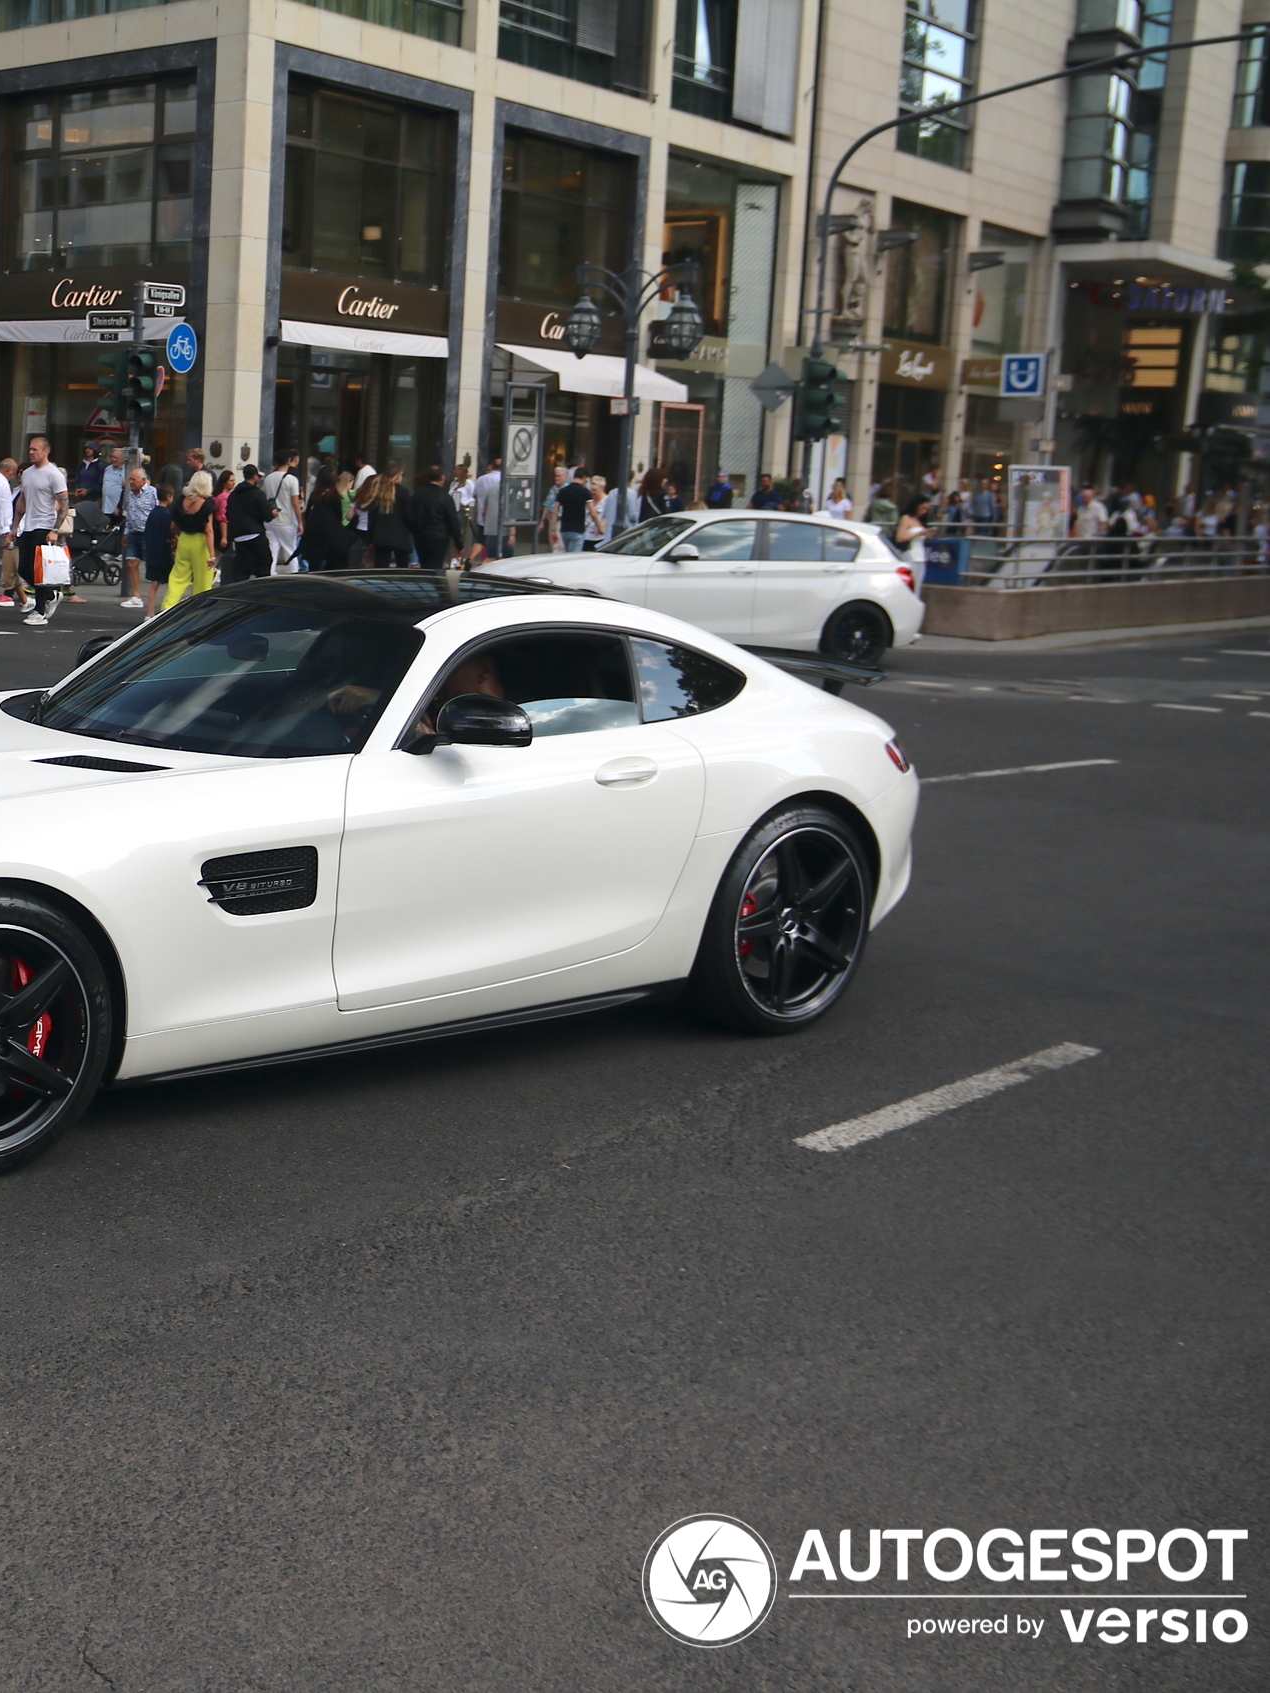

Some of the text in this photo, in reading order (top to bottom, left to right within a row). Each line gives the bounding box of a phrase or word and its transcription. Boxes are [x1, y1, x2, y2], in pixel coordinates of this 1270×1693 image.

[51, 278, 123, 308] Cartier
[150, 289, 180, 300] Königsallee
[1128, 286, 1227, 313] SATURN
[337, 285, 399, 320] Cartier
[92, 317, 127, 327] Steinstraße
[64, 325, 97, 341] Cartier
[354, 334, 385, 351] Cartier
[223, 879, 292, 892] V8 BITURBO
